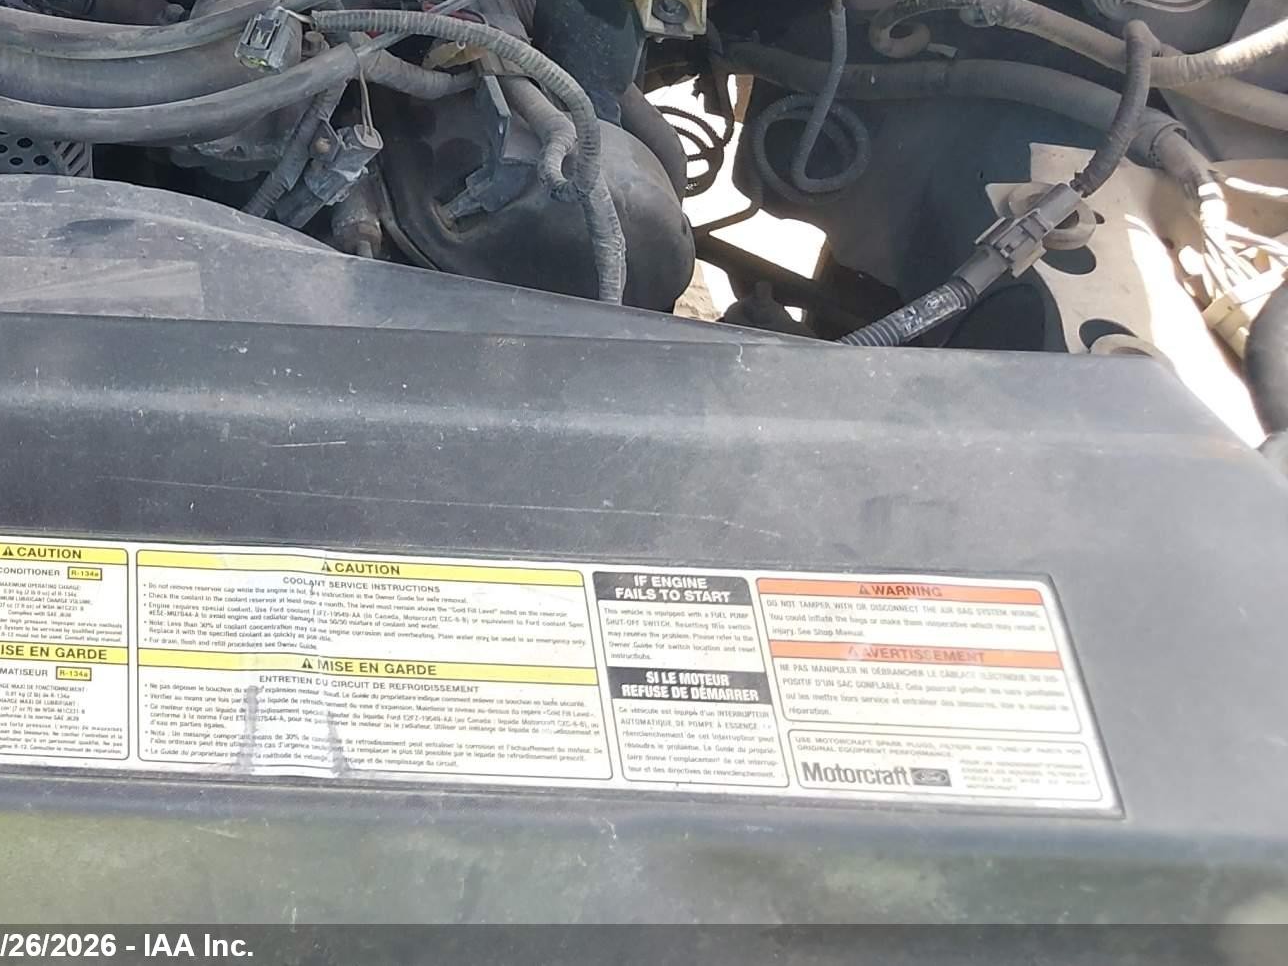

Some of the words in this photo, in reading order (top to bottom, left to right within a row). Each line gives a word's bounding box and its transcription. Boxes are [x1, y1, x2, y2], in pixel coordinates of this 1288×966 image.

[17, 546, 82, 559] CAUTION
[70, 570, 99, 578] R-134a
[334, 562, 400, 576] CAUTION
[282, 577, 326, 587] COOLANT
[328, 580, 368, 590] SERVICE
[371, 583, 440, 593] INSTRUCTIONS
[634, 575, 647, 586] IF
[651, 576, 708, 589] ENGINE
[615, 588, 656, 600] FAILS
[659, 590, 681, 601] TO
[684, 590, 731, 603] START
[871, 584, 942, 597] WARNING
[780, 600, 796, 608] NOT
[30, 646, 50, 657] EN
[55, 647, 108, 660] GARDE
[864, 647, 984, 663] AVERTISSEMENT
[59, 670, 88, 678] R-134a
[317, 660, 354, 672] MISE
[359, 662, 378, 674] EN
[384, 664, 438, 676] GARDE
[260, 674, 312, 685] ENTRETIEN
[330, 680, 370, 688] CIRCUIT
[372, 682, 386, 690] DE
[388, 682, 480, 694] REFROIDISSEMENT
[645, 670, 658, 684] SI
[662, 672, 676, 684] LE
[678, 672, 730, 686] MOTEUR
[621, 684, 669, 698] REFUSE
[670, 686, 688, 699] DE
[800, 762, 911, 786] Motorcraft
